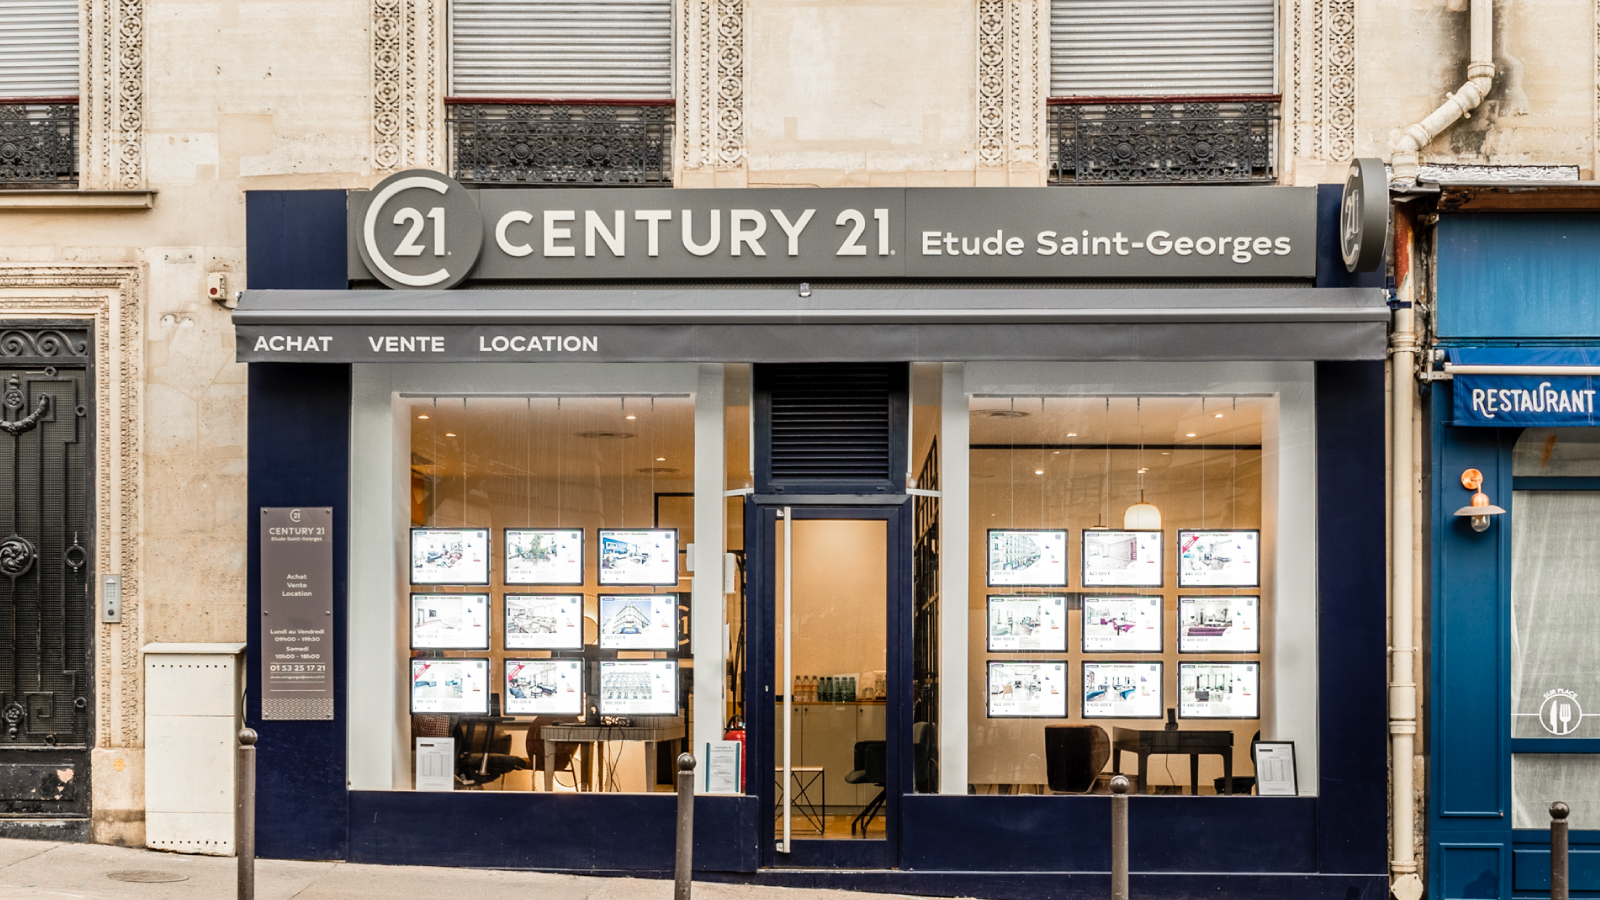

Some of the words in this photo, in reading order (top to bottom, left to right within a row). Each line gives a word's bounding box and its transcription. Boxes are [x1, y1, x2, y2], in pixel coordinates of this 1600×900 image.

[495, 208, 816, 257] CENTURY
[922, 229, 1026, 257] Etude
[1036, 229, 1292, 264] Saint-Georges
[253, 335, 333, 352] ACHAT
[368, 336, 446, 352] VENTE
[479, 336, 599, 352] LOCATION
[1471, 382, 1597, 419] RESTAURANT
[268, 527, 314, 535] CENTURY
[316, 527, 325, 535] 21
[1542, 688, 1556, 698] SUR
[1557, 688, 1578, 698] PLACE
